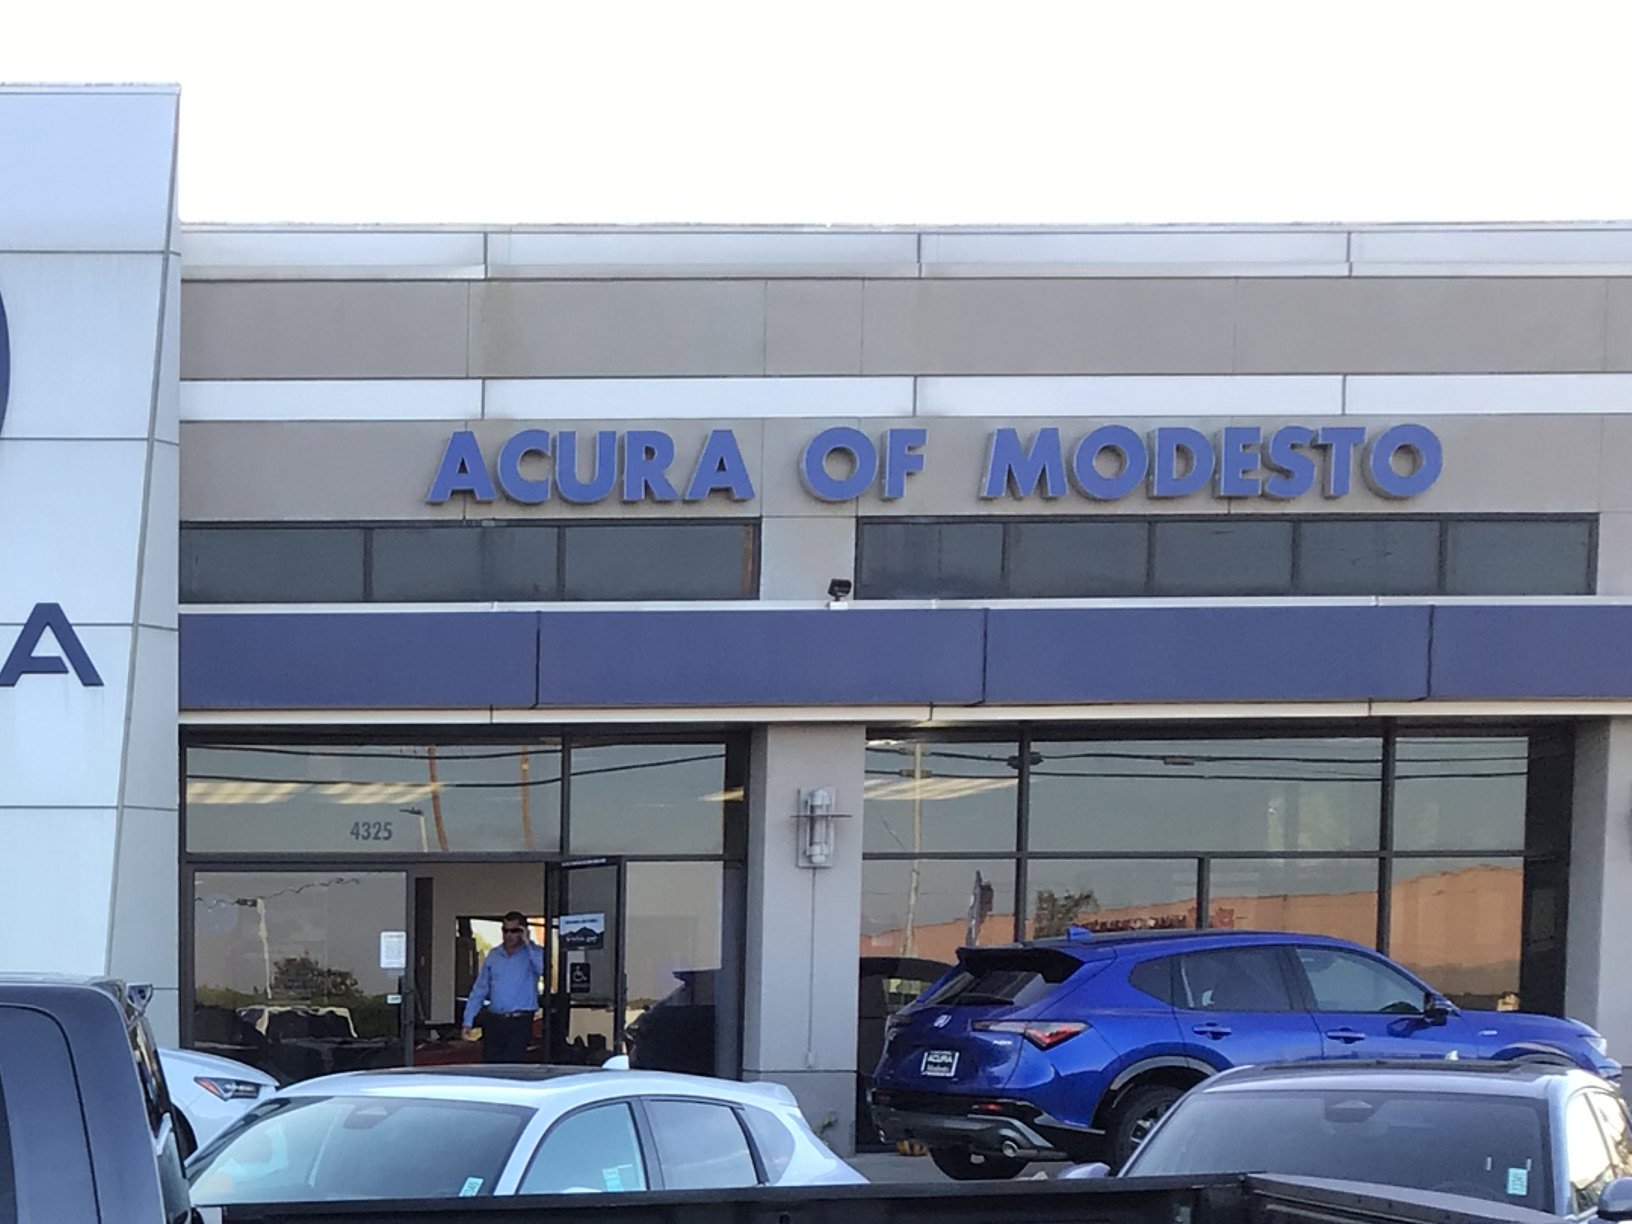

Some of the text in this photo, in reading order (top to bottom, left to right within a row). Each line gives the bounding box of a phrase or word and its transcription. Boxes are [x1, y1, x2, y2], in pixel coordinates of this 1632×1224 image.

[425, 422, 1444, 503] ACURA OF MODESTO
[350, 821, 393, 841] 4325
[927, 1054, 953, 1063] ACURA
